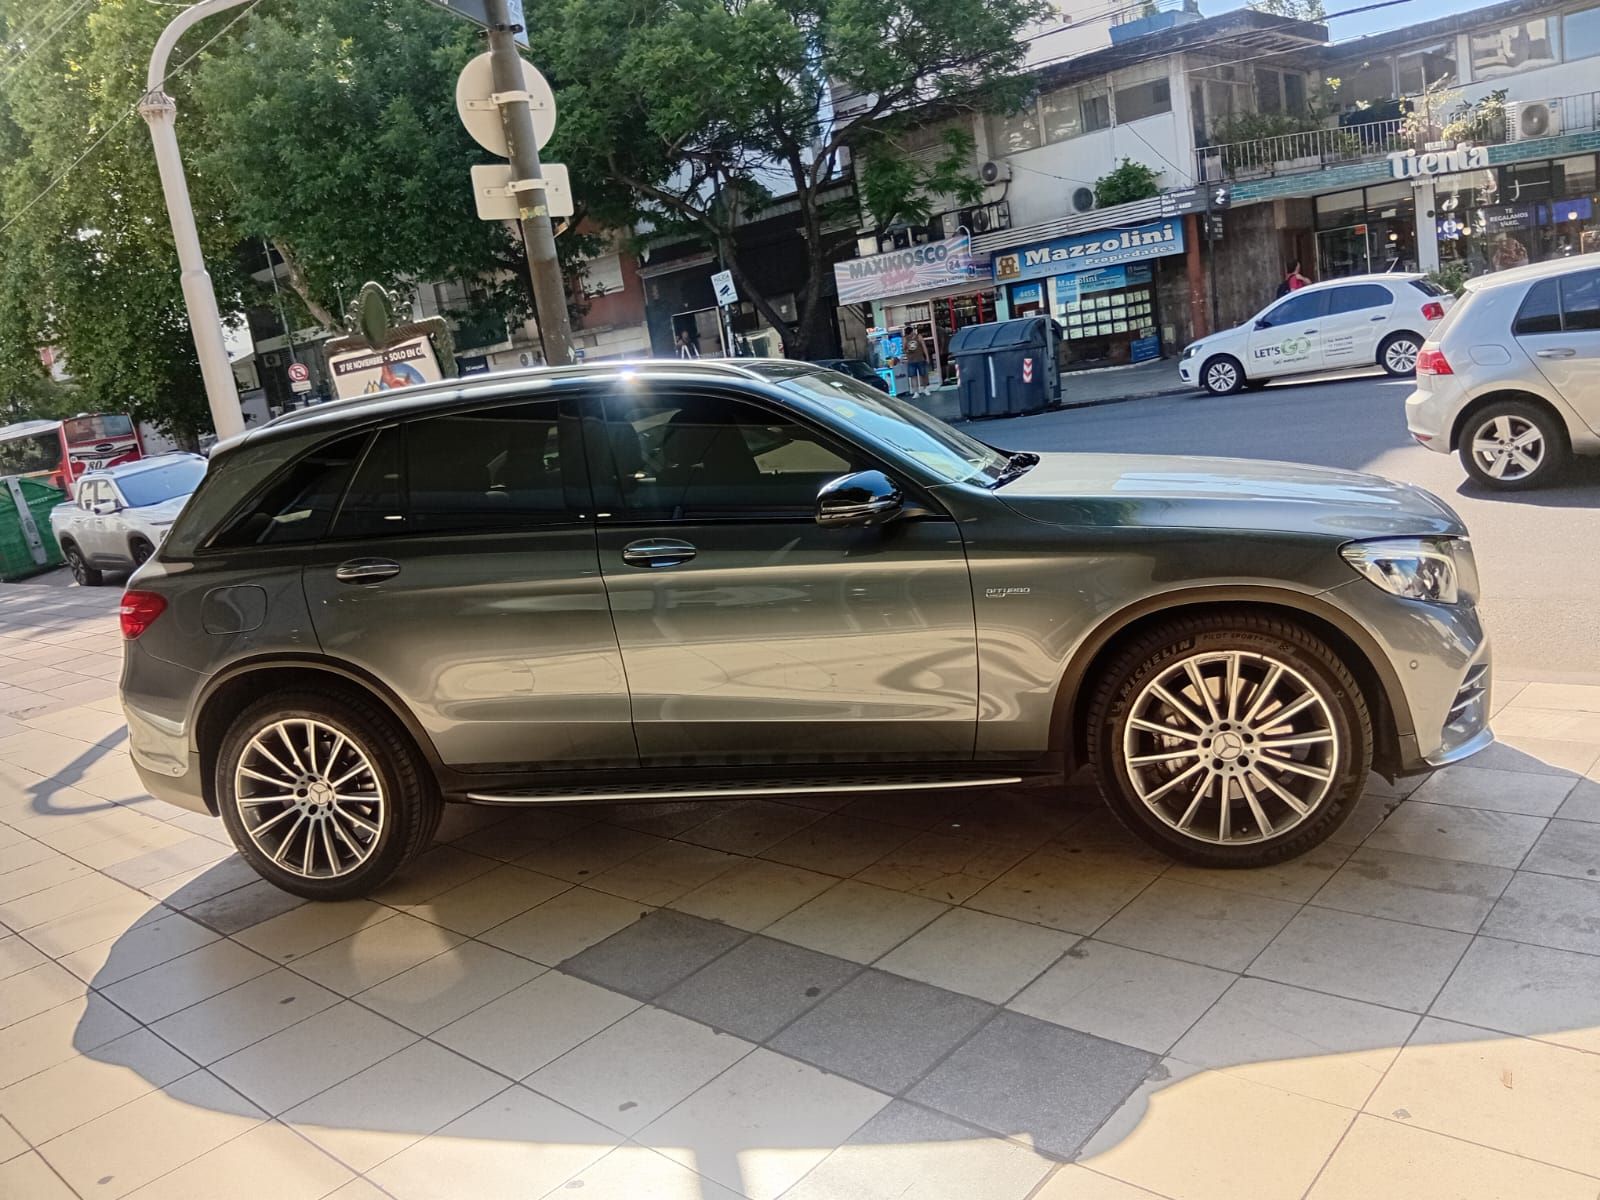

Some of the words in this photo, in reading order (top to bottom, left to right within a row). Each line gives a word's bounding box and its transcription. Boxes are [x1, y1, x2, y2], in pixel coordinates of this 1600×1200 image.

[1489, 211, 1529, 223] REGALAMOS
[1025, 223, 1175, 267] Mazzolini
[1084, 245, 1176, 266] Propiedades
[849, 244, 948, 280] MAXIKIOSCO
[353, 354, 384, 370] NOVIEMBRE
[388, 351, 407, 363] SOLO
[407, 348, 415, 358] EN
[1254, 346, 1280, 359] LET'S
[88, 459, 103, 472] 80
[1119, 638, 1192, 699] MICHELIN
